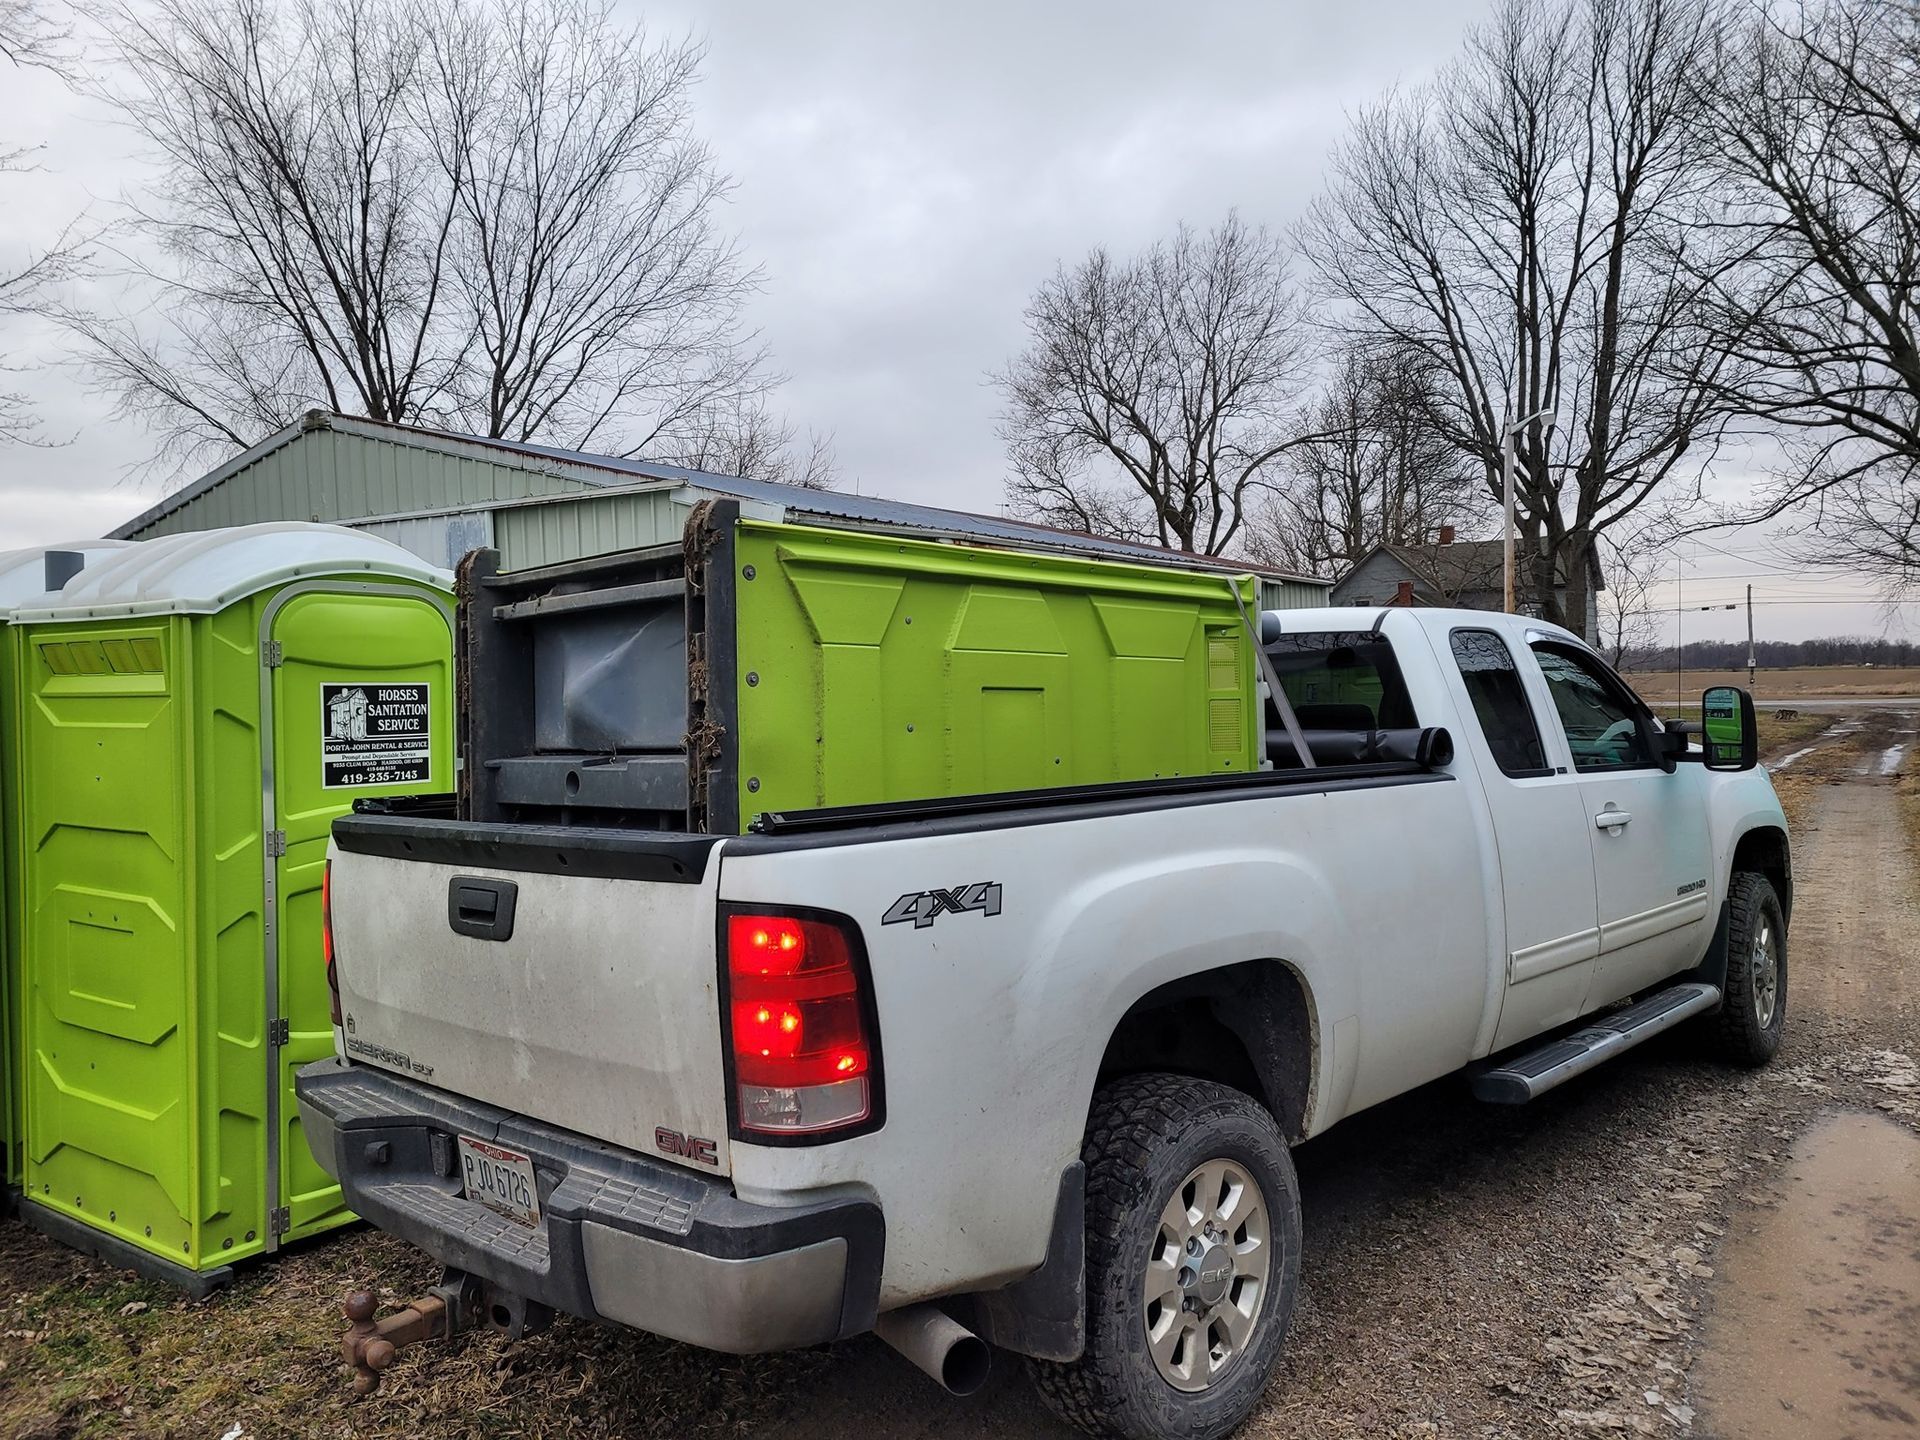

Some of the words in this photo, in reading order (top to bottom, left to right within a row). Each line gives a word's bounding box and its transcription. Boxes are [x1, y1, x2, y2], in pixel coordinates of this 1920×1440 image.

[378, 689, 418, 701] HORSES
[368, 704, 427, 716] SANITATION
[378, 718, 420, 731] SERVICE
[326, 743, 371, 751] PORTA-JOHN
[371, 742, 396, 750] RENTAL
[403, 741, 428, 749] SERVICE
[341, 770, 418, 784] 419-235-7143
[347, 1038, 411, 1069] SIERRA
[412, 1062, 434, 1076] SLT
[484, 1145, 503, 1160] OHIO
[655, 1126, 718, 1166] GMC
[1202, 1266, 1230, 1283] GMC
